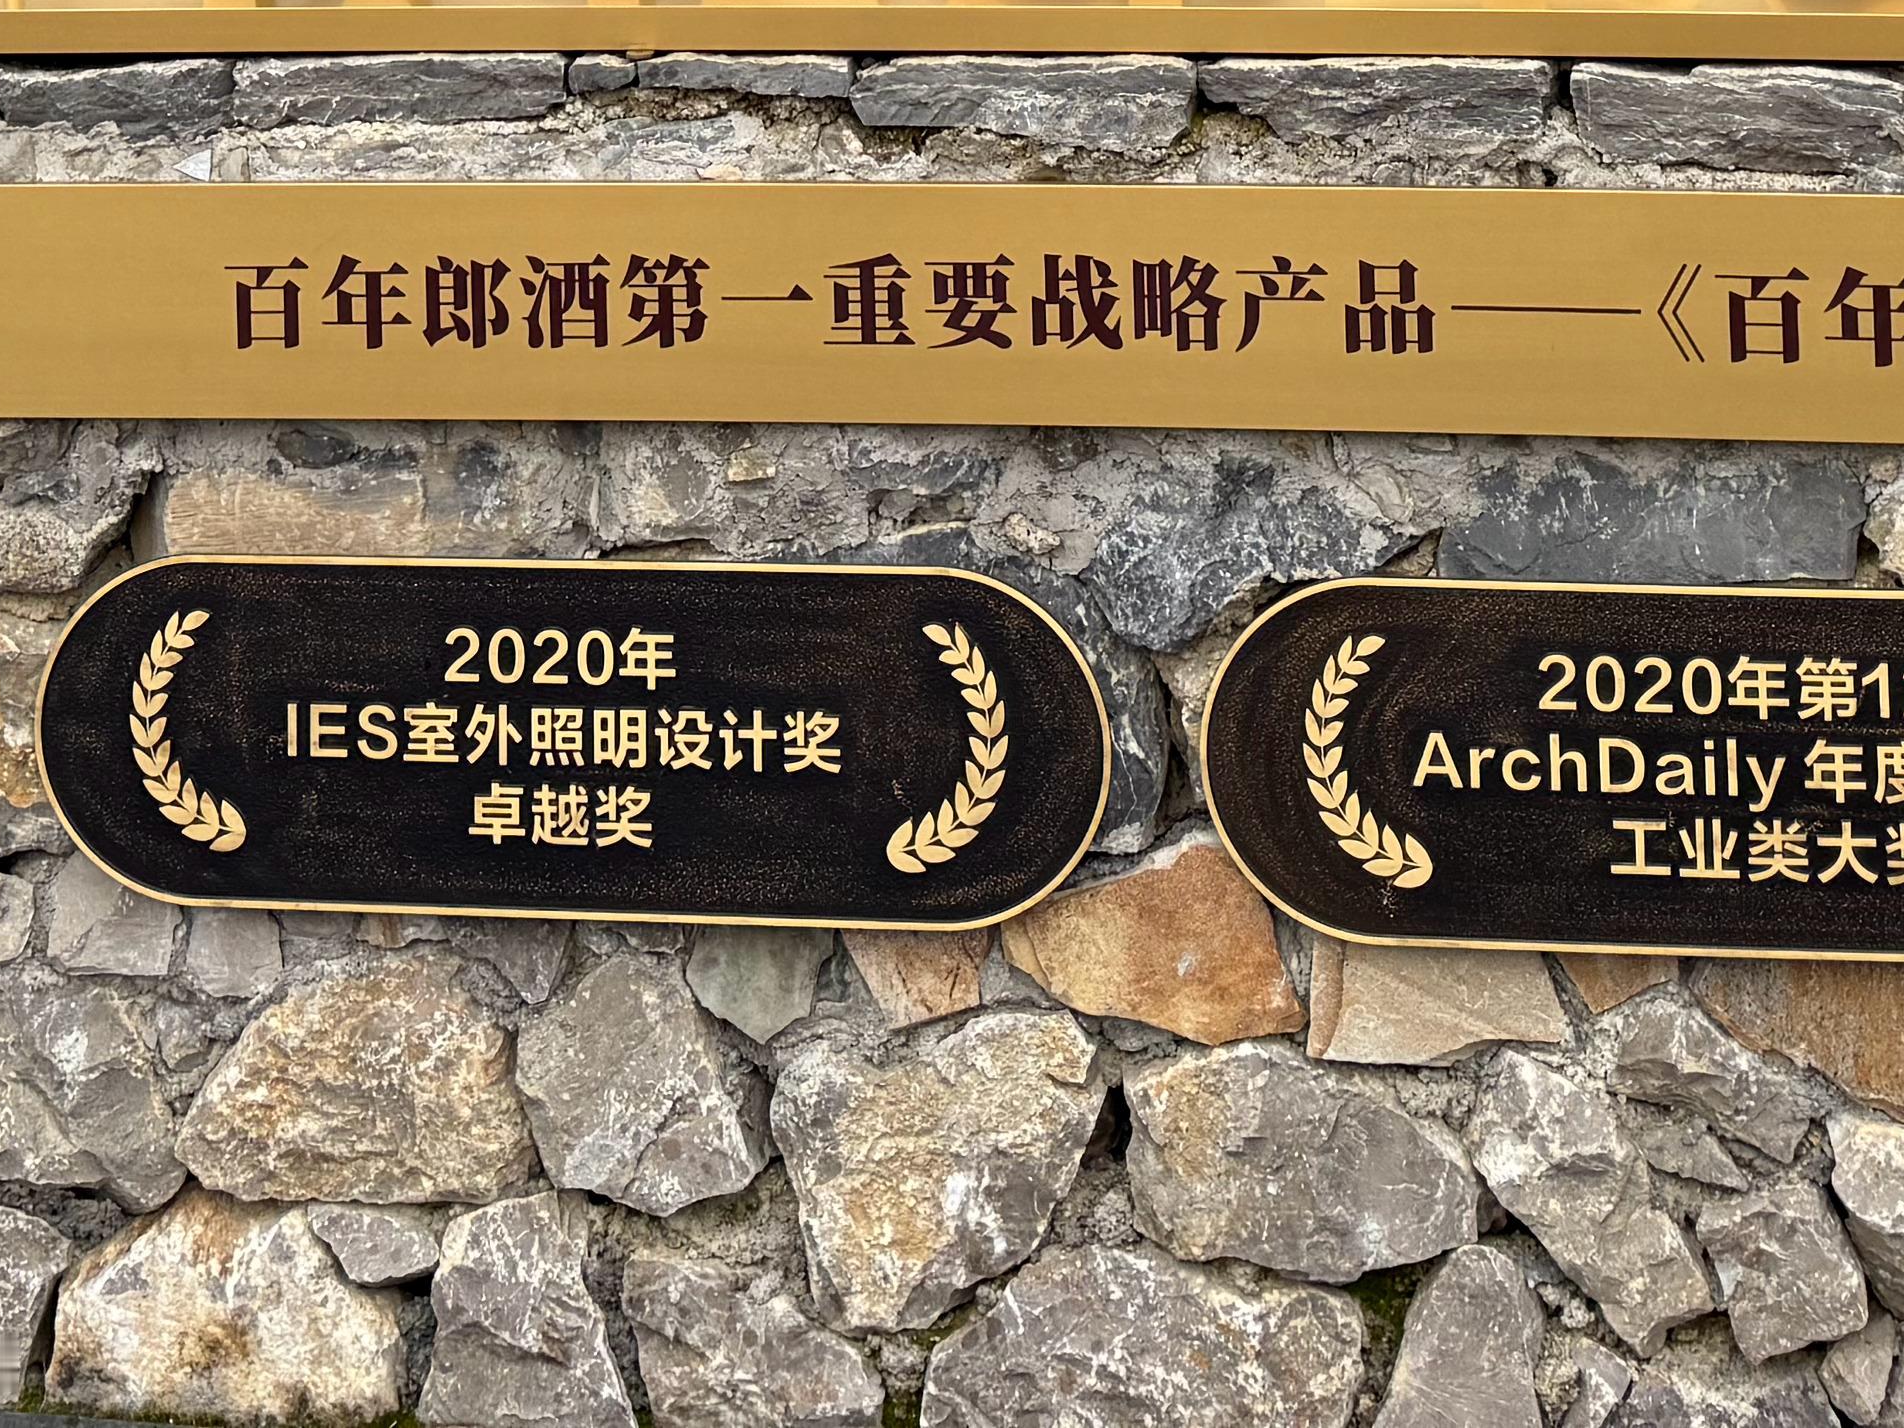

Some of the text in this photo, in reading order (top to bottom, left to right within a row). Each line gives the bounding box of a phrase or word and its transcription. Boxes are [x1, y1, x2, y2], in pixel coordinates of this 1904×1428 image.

[444, 626, 676, 691] 2020年
[285, 701, 840, 775] IES室外照明设计奖
[1411, 731, 1784, 812] ArchDaily
[467, 783, 653, 849] 卓越奖
